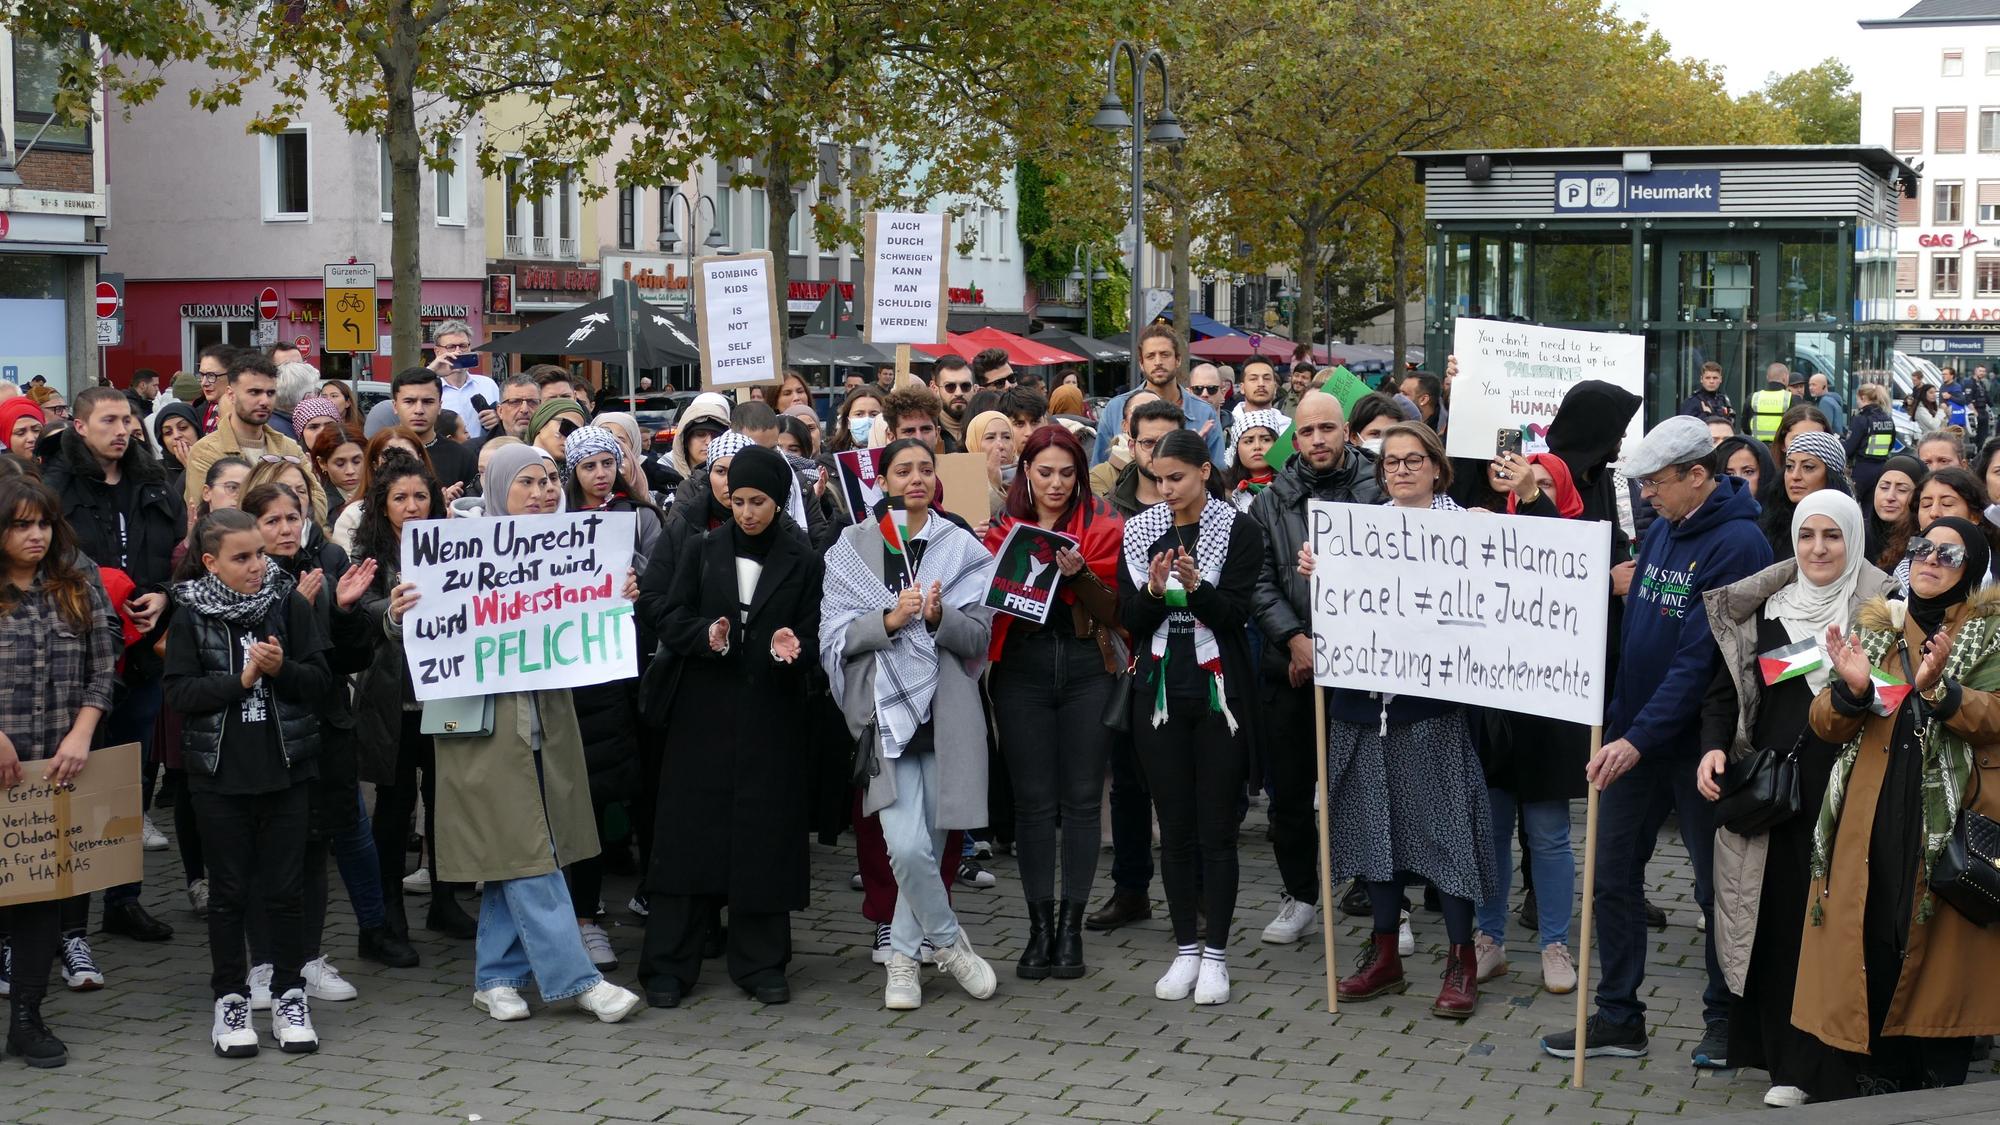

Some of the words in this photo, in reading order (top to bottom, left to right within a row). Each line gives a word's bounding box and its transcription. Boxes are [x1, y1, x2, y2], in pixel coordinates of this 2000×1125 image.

[1630, 183, 1712, 200] Heumarkt
[890, 222, 921, 231] AUCH
[887, 237, 924, 246] DURCH
[1918, 233, 1954, 248] GAG
[880, 253, 933, 262] SCHWEIGEN
[331, 267, 371, 276] Gürzenich-
[711, 268, 759, 280] BOMBING
[892, 266, 922, 276] KANN
[724, 284, 748, 294] KIDS
[894, 284, 918, 293] MAN
[180, 303, 256, 318] CURRYWURS
[732, 306, 743, 315] IS
[878, 298, 932, 309] SCHULDIG
[421, 304, 470, 318] BRATWURST
[1935, 307, 1961, 321] XII
[728, 321, 749, 331] NOT
[880, 317, 928, 327] WERDEN!
[728, 341, 753, 352] SELF
[1478, 329, 1494, 344] You
[1502, 333, 1529, 348] don't
[1540, 338, 1566, 351] need
[1571, 339, 1581, 352] to
[1590, 342, 1602, 352] be
[1949, 341, 1982, 350] Heumarkt
[717, 355, 766, 368] DEFENSE!
[1495, 348, 1530, 359] muslim
[1538, 351, 1548, 362] to
[1552, 350, 1581, 364] stand
[1586, 356, 1597, 368] up
[1603, 355, 1617, 367] for
[1482, 381, 1501, 396] You
[1511, 386, 1530, 398] just
[1535, 387, 1556, 397] need
[412, 525, 484, 567] Wenn
[493, 514, 603, 562] Unrecht
[1311, 509, 1468, 570] Palästina
[442, 569, 474, 593] zu
[478, 558, 543, 592] Recht
[550, 548, 603, 577] wird,
[472, 573, 613, 627] Widerstand
[1003, 592, 1046, 617] FREE
[1314, 575, 1405, 617] Israel
[1438, 578, 1486, 620] alle
[1495, 581, 1579, 636] Juden
[418, 654, 465, 685] zur
[474, 605, 634, 683] PFLICHT
[1312, 630, 1432, 688] Besatzung
[1457, 645, 1591, 699] Menschenrechte
[242, 709, 267, 723] FREE
[14, 853, 35, 866] für
[40, 848, 57, 860] die
[69, 835, 126, 852] Verbrechen
[29, 858, 91, 881] HAMAS
